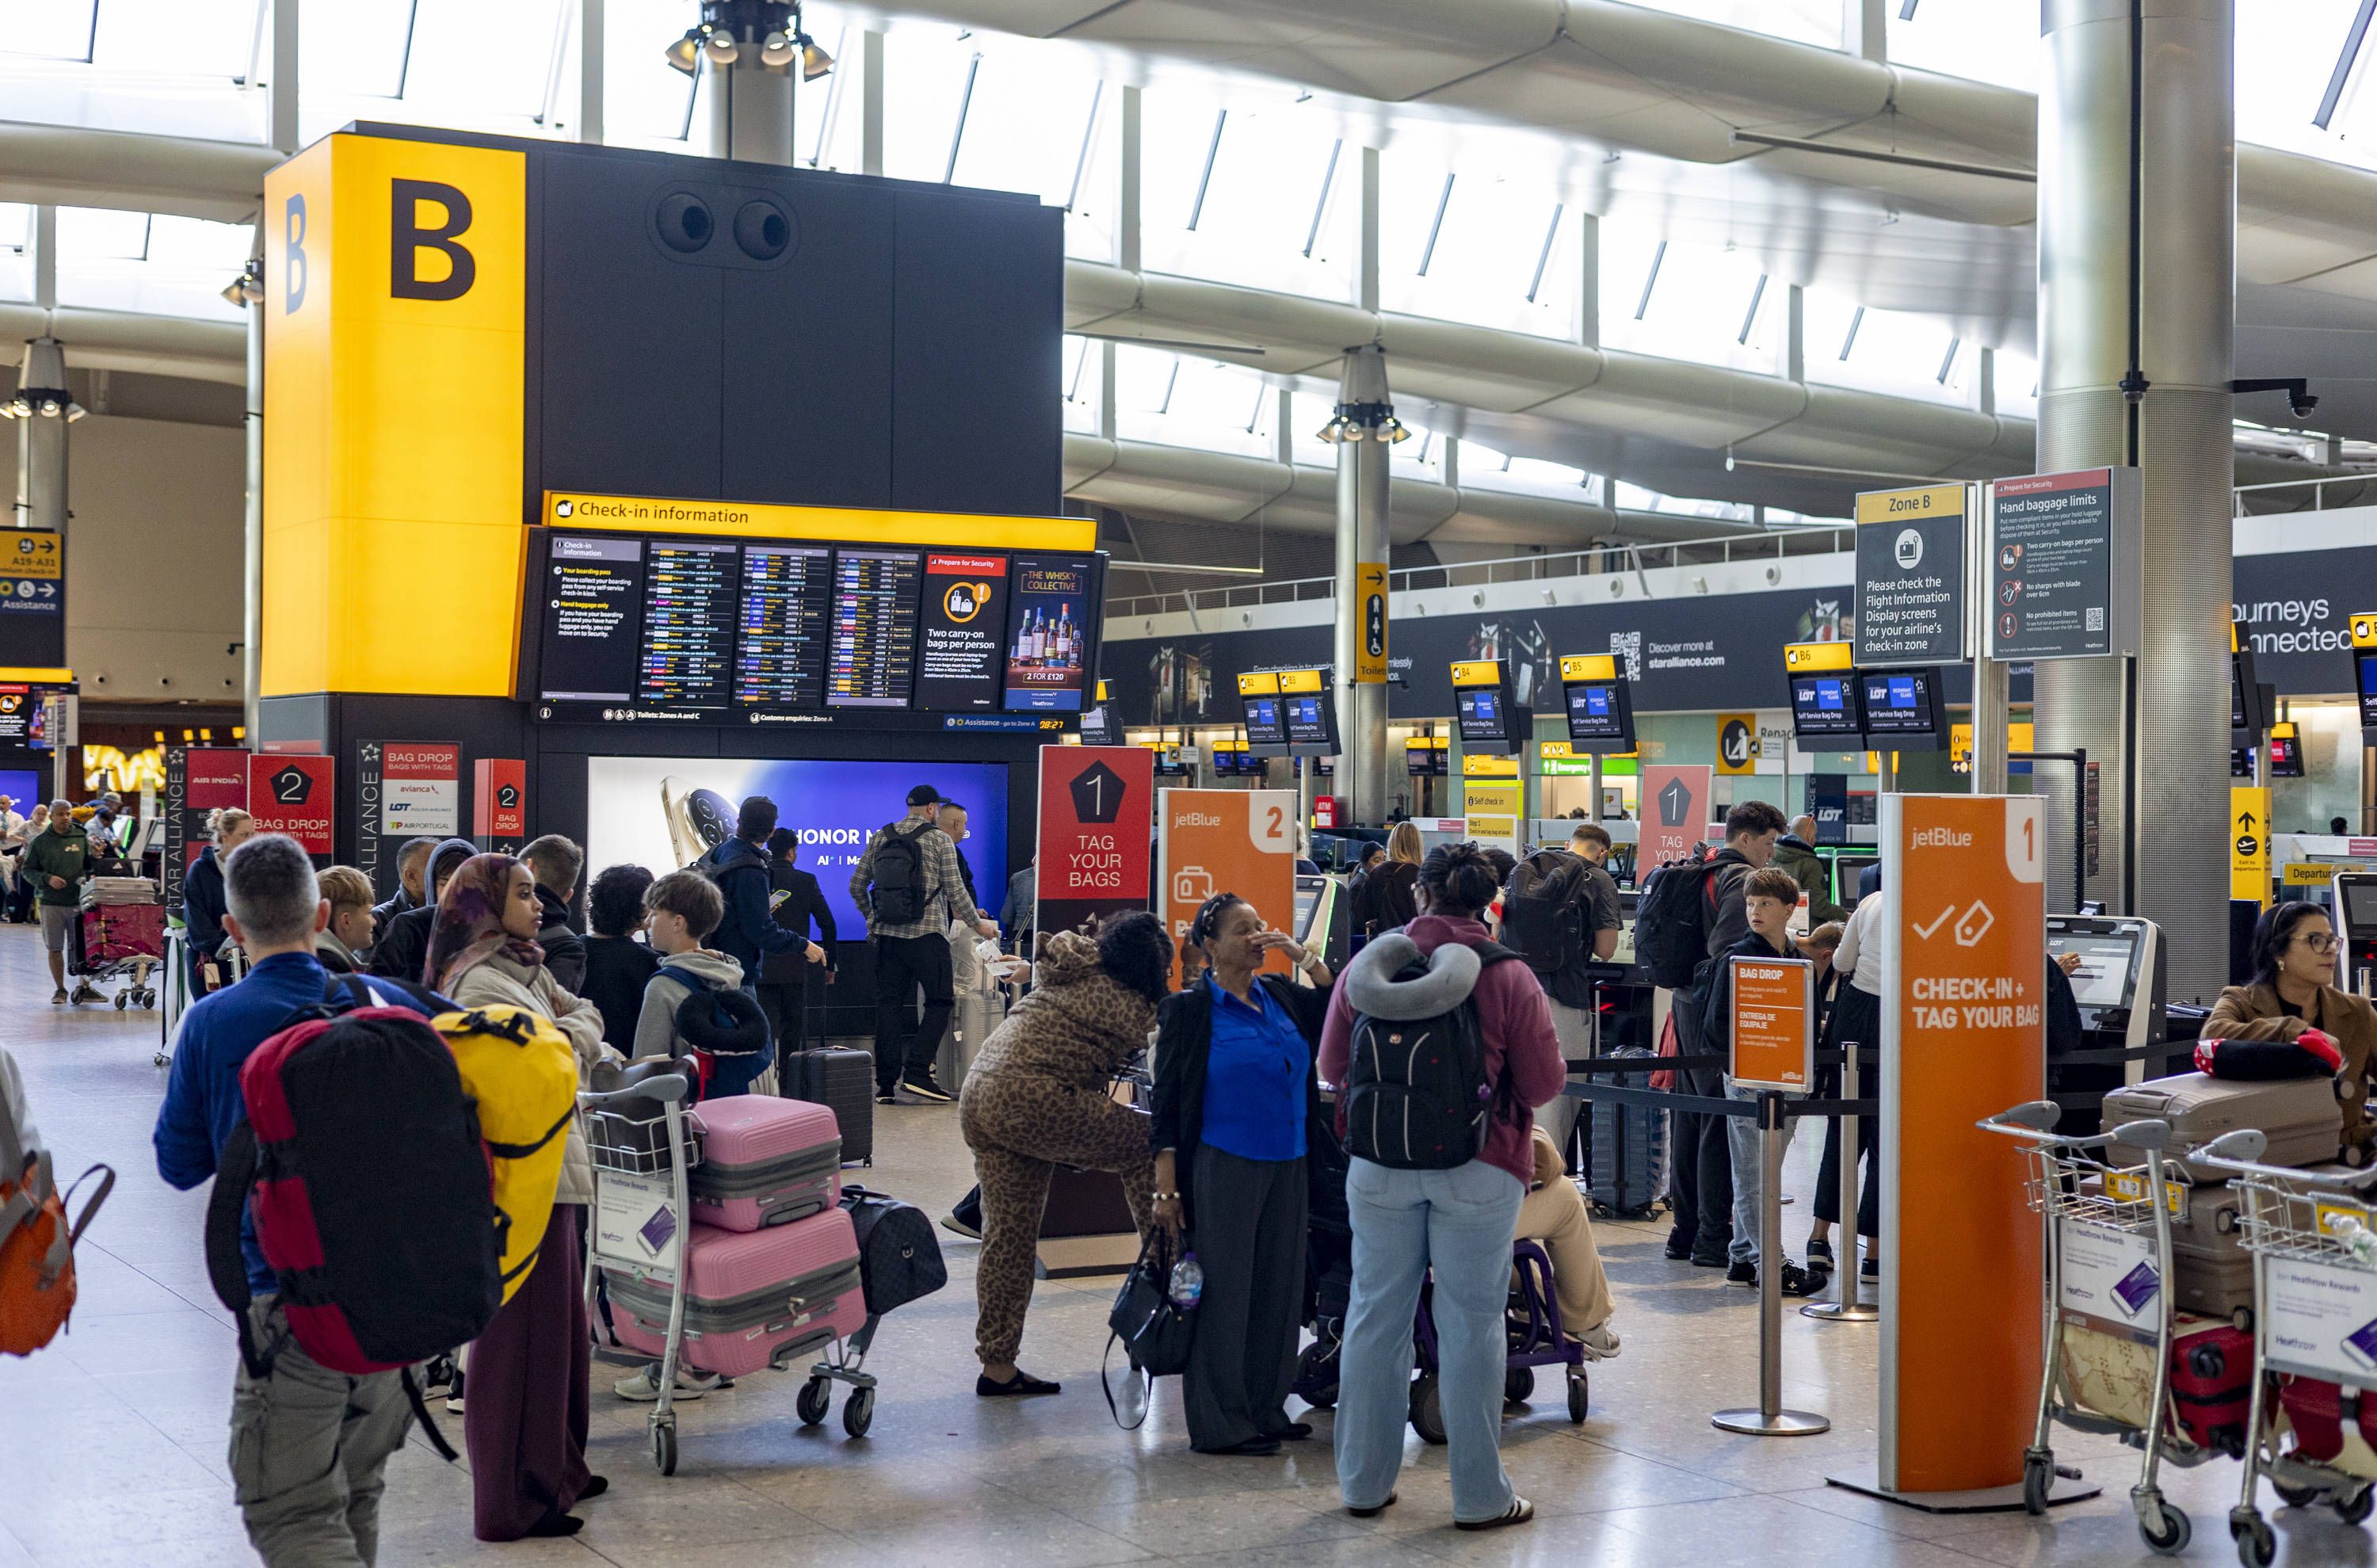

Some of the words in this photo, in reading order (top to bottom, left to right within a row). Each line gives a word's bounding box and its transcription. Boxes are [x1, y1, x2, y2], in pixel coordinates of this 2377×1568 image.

[391, 177, 475, 301] B
[286, 193, 306, 315] B
[1889, 498, 1920, 512] Zone
[1923, 495, 1930, 509] B
[2000, 501, 2024, 513] Hand
[2027, 498, 2068, 512] baggage
[2070, 494, 2097, 506] limits
[580, 502, 648, 518] Check-in
[654, 505, 748, 524] information
[1028, 570, 1044, 579] THE
[1045, 571, 1077, 580] WHISKY
[1027, 581, 1076, 590] COLLECTIVE
[1867, 579, 1895, 591] Please
[1898, 577, 1923, 589] check
[1925, 576, 1941, 587] the
[2, 600, 56, 610] Assistance
[1867, 595, 1892, 609] Flight
[1894, 592, 1950, 605] Information
[1867, 610, 1899, 624] Display
[1902, 608, 1936, 619] screens
[2035, 611, 2062, 620] prohibited
[2232, 598, 2329, 627] ourneys
[948, 630, 984, 639] carry-on
[1866, 626, 1878, 637] for
[1881, 627, 1902, 639] your
[927, 639, 948, 649] bags
[949, 641, 964, 650] per
[966, 641, 994, 650] person
[1649, 643, 1681, 654] Discover
[1683, 643, 1704, 651] more
[1705, 640, 1713, 650] at
[1865, 639, 1902, 652] check-in
[1905, 639, 1928, 650] zone
[2250, 627, 2353, 654] nnected
[1800, 650, 1811, 661] B6
[1573, 662, 1581, 671] B5
[1649, 656, 1725, 669] staralliance.com
[1360, 666, 1387, 675] Toilets
[1462, 668, 1471, 677] B4
[1799, 691, 1815, 701] LOT
[1870, 689, 1887, 700] LOT
[1573, 699, 1586, 708] LOT
[1040, 720, 1063, 729] 08:27
[388, 753, 414, 762] BAG
[418, 753, 453, 762] DROP
[1558, 763, 1585, 773] Emergency
[280, 773, 302, 800] 2
[502, 788, 514, 806] 2
[1086, 775, 1101, 815] 1
[1484, 796, 1498, 805] check
[1318, 802, 1331, 811] ATM
[1668, 788, 1677, 821] 1
[168, 772, 184, 862] ALLIANCE
[1174, 812, 1221, 829] jetBlue
[1266, 806, 1283, 837] 2
[1818, 809, 1843, 822] LOT
[254, 819, 284, 830] BAG
[288, 819, 329, 830] DROP
[795, 829, 860, 845] HONOR
[1078, 835, 1115, 850] TAG
[1661, 836, 1683, 848] TAG
[1911, 827, 1972, 849] jetBlue
[2024, 818, 2034, 861] 1
[1069, 853, 1122, 868] YOUR
[1655, 850, 1686, 862] YOUR
[1070, 872, 1120, 887] BAGS
[1739, 968, 1758, 979] BAG
[1759, 969, 1784, 980] DROP
[1913, 977, 2013, 1000] CHECK-IN
[1739, 1012, 1767, 1021] ENTREGA
[1912, 1006, 1958, 1028] TAG
[1962, 1006, 2013, 1028] YOUR
[2016, 1004, 2040, 1028] BAG
[1739, 1021, 1768, 1029] EQUIPAJE
[1781, 1071, 1803, 1081] jetBlue
[2291, 1273, 2327, 1288] Heathrow
[2329, 1280, 2360, 1293] Rewards
[2276, 1335, 2317, 1351] Heathrow
